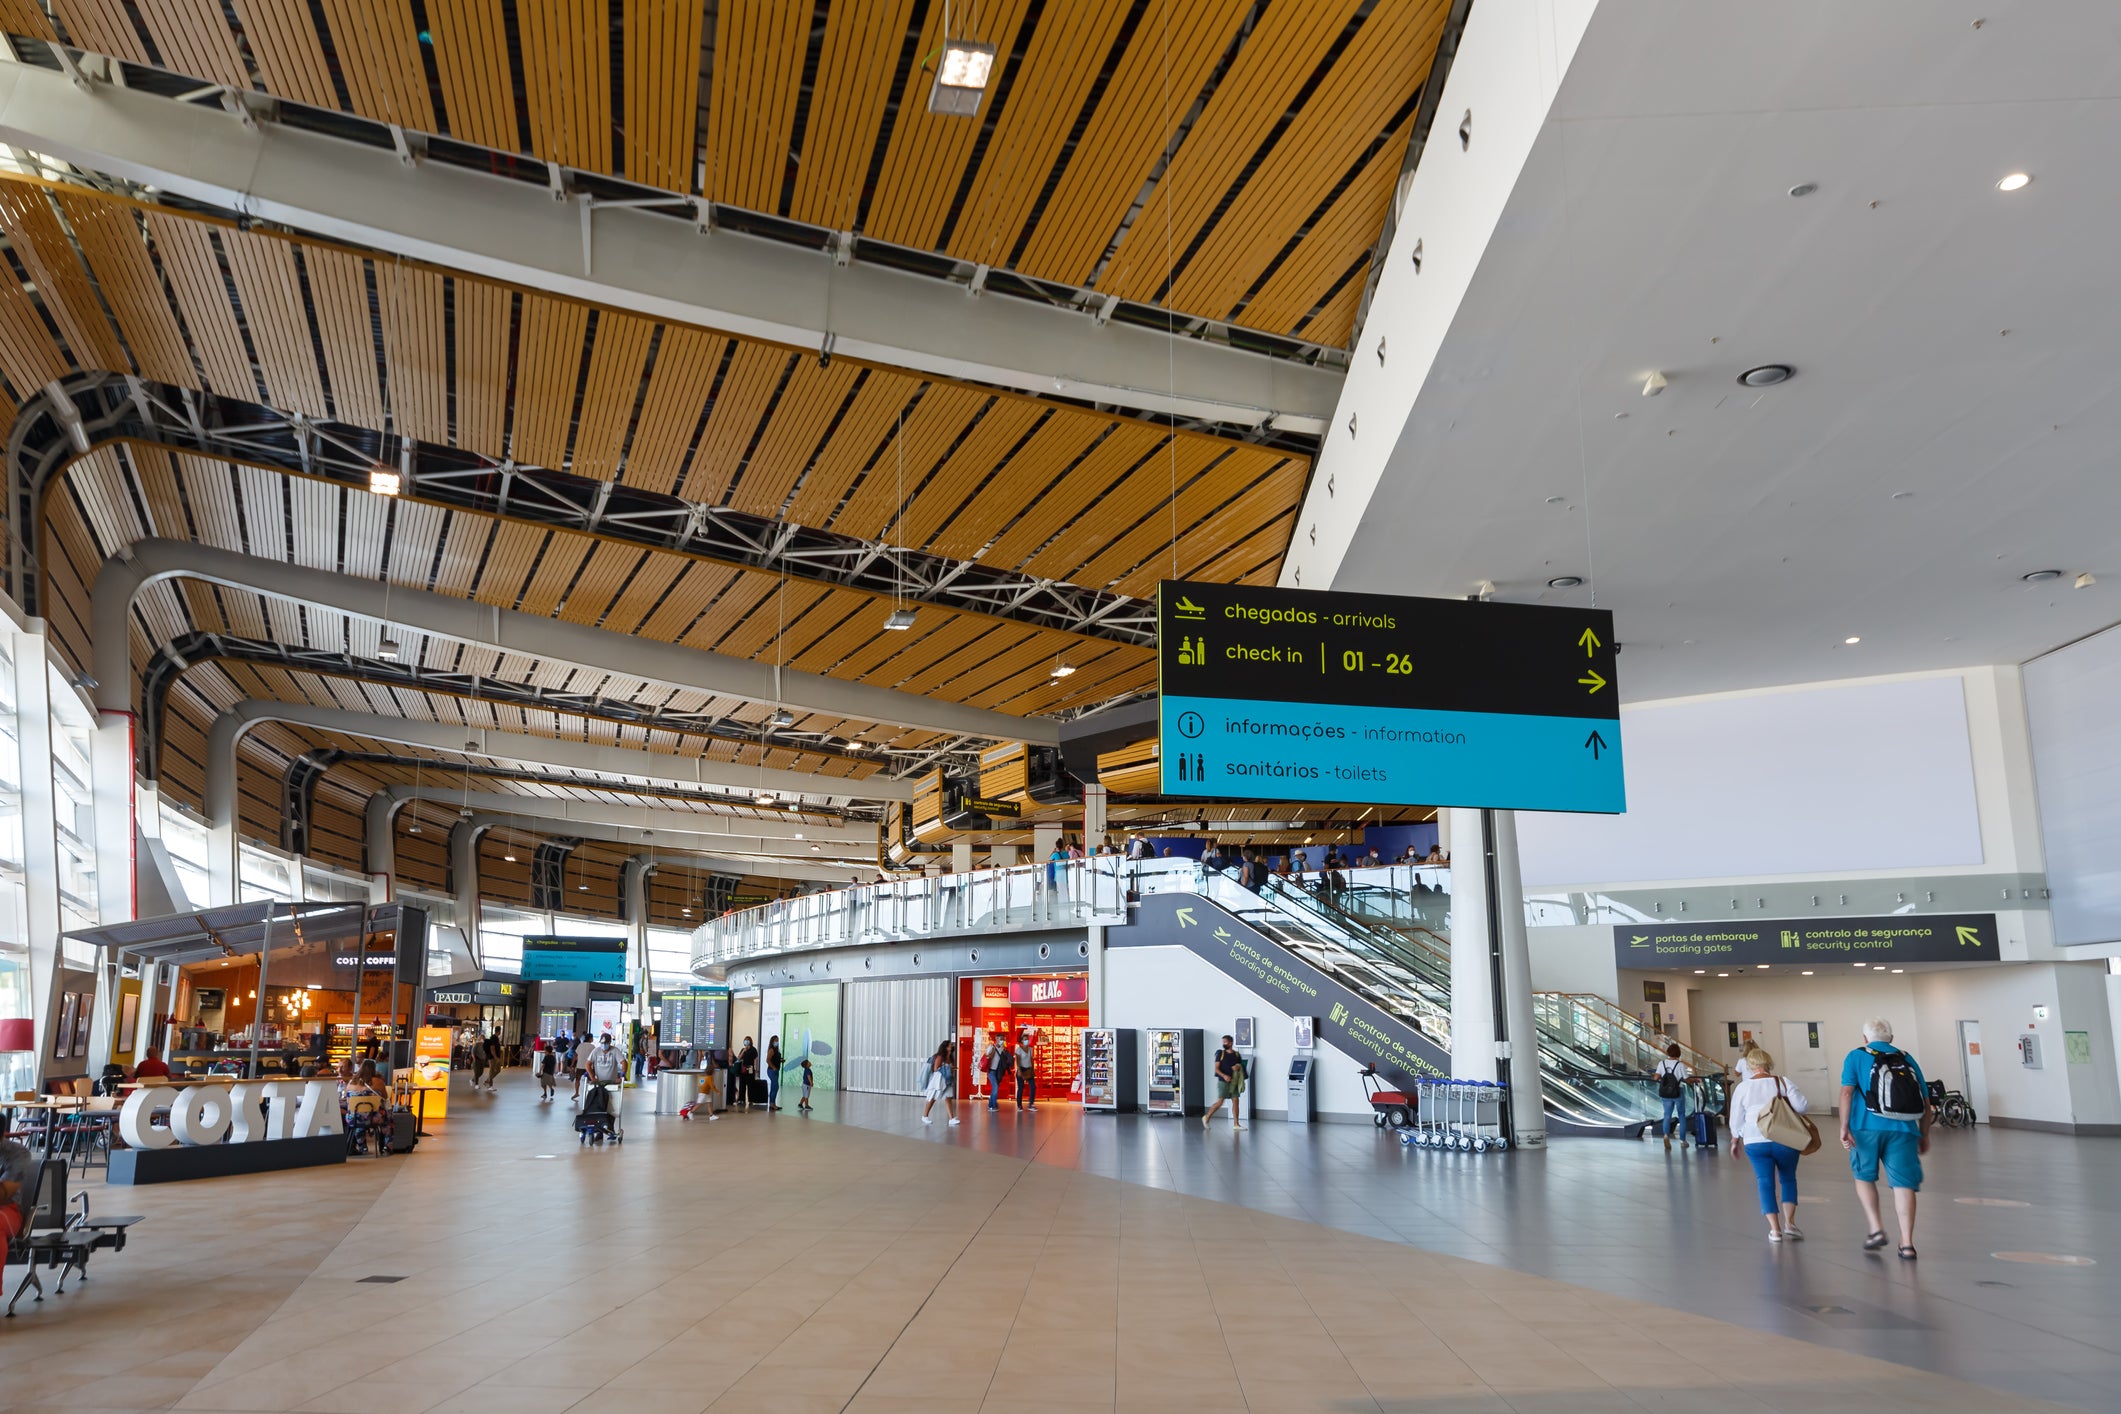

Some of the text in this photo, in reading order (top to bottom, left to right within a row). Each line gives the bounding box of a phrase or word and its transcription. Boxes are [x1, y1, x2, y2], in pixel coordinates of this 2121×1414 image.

[1224, 603, 1318, 625] chegadas
[1333, 612, 1397, 629] arrivals
[1226, 644, 1282, 662] check
[1287, 647, 1303, 663] in
[1343, 650, 1364, 672] 01
[1386, 653, 1413, 675] 26
[1225, 717, 1346, 741] informações
[1364, 724, 1466, 745] information
[1226, 761, 1319, 779] sanitários
[1334, 765, 1388, 782] toilets
[1655, 933, 1759, 944] portas de embarque
[1805, 926, 1933, 939] controlo de segurança
[1656, 944, 1733, 954] boarding gates
[1806, 940, 1893, 951] security control
[336, 957, 396, 966] COST COFFE
[1229, 948, 1291, 994] boarding gates
[1233, 940, 1317, 997] portas de embarque
[439, 993, 470, 1003] PAUL
[1032, 980, 1059, 1001] RELAY
[1348, 1027, 1385, 1057] security
[1353, 1017, 1451, 1079] controlo de seguran
[119, 1081, 344, 1149] COSTA
